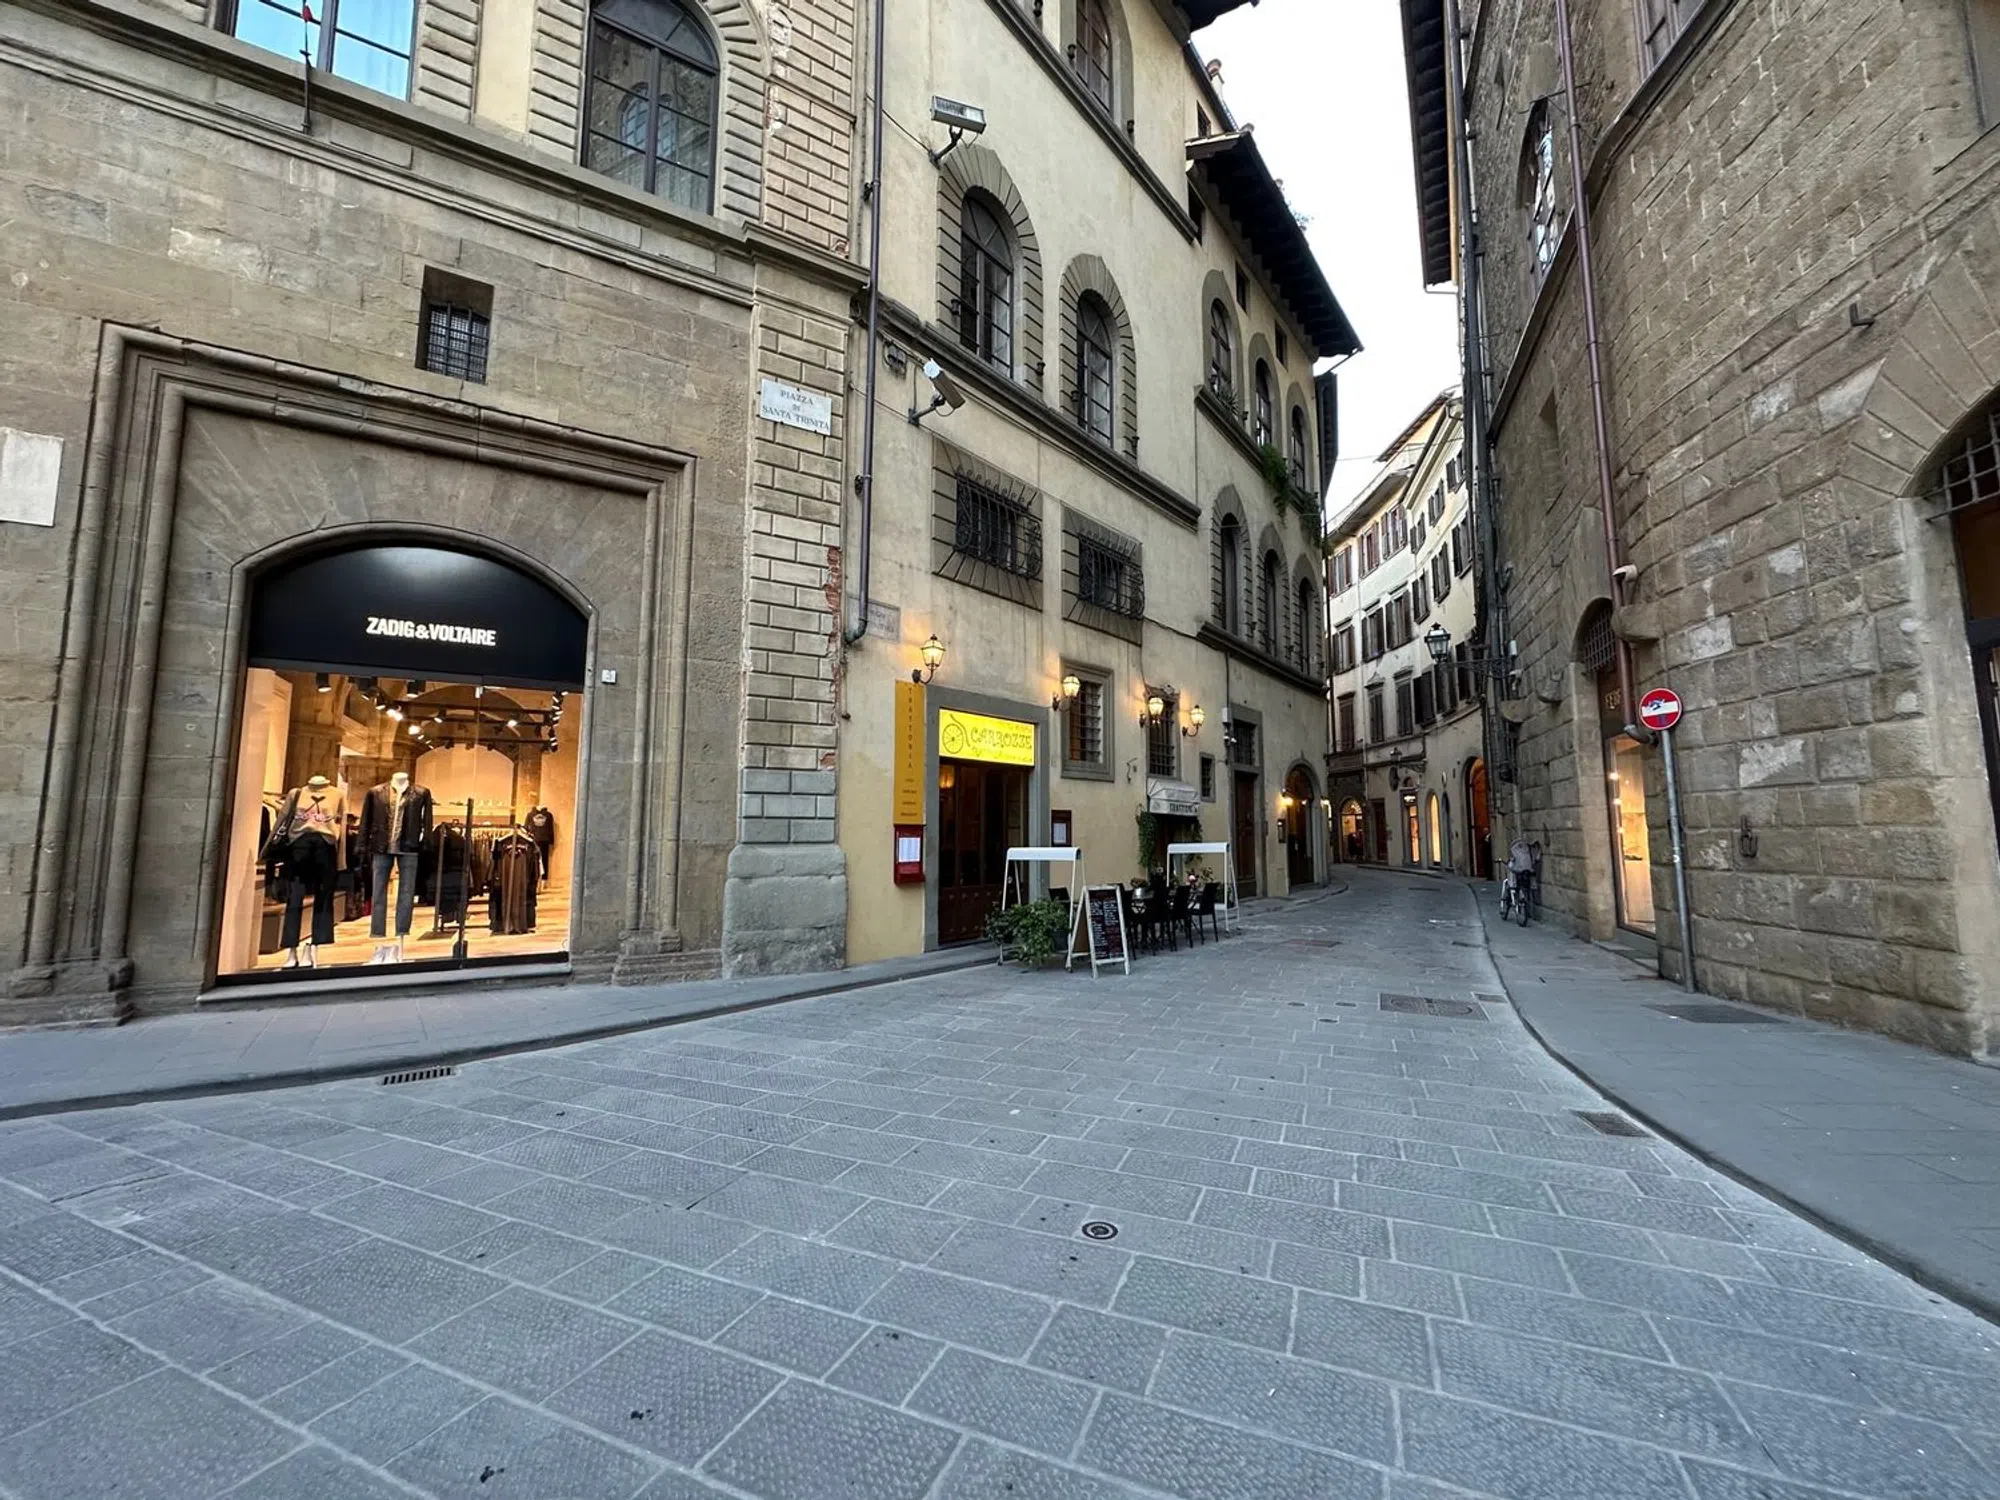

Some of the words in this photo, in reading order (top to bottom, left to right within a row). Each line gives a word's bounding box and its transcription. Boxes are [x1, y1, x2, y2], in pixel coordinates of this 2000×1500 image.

[781, 389, 814, 406] PIAZZA
[762, 404, 791, 420] SANTA
[366, 616, 497, 646] ZADIG&VOLTAIRE
[970, 726, 1033, 750] CARROZZE
